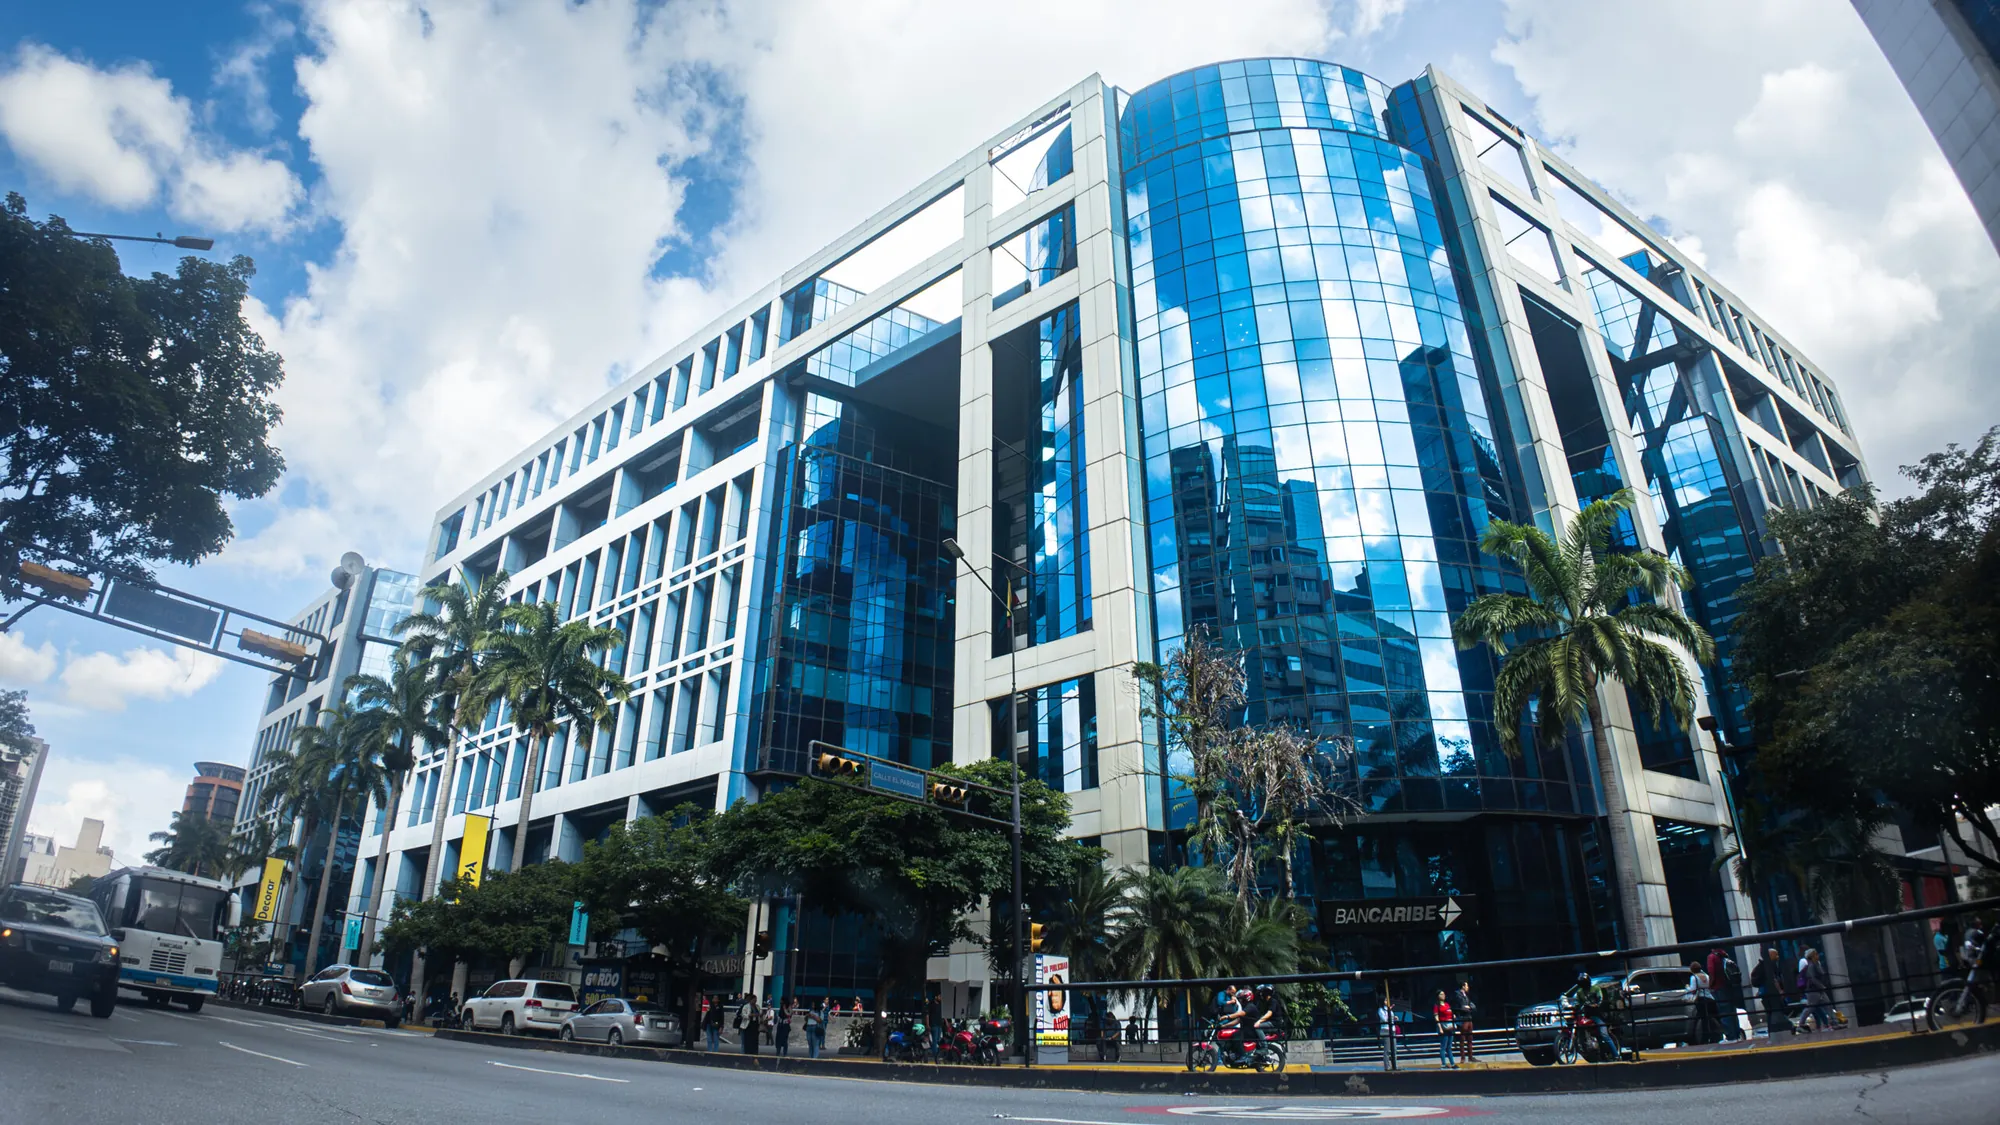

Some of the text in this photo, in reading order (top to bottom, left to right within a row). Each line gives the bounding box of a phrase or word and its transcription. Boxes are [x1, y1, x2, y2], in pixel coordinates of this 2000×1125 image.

[873, 771, 891, 782] CALLE
[900, 779, 920, 790] PARQUE
[257, 879, 275, 919] Decorar
[1334, 904, 1438, 925] BANCARIBE
[1036, 957, 1044, 1029] DISPOIBLE
